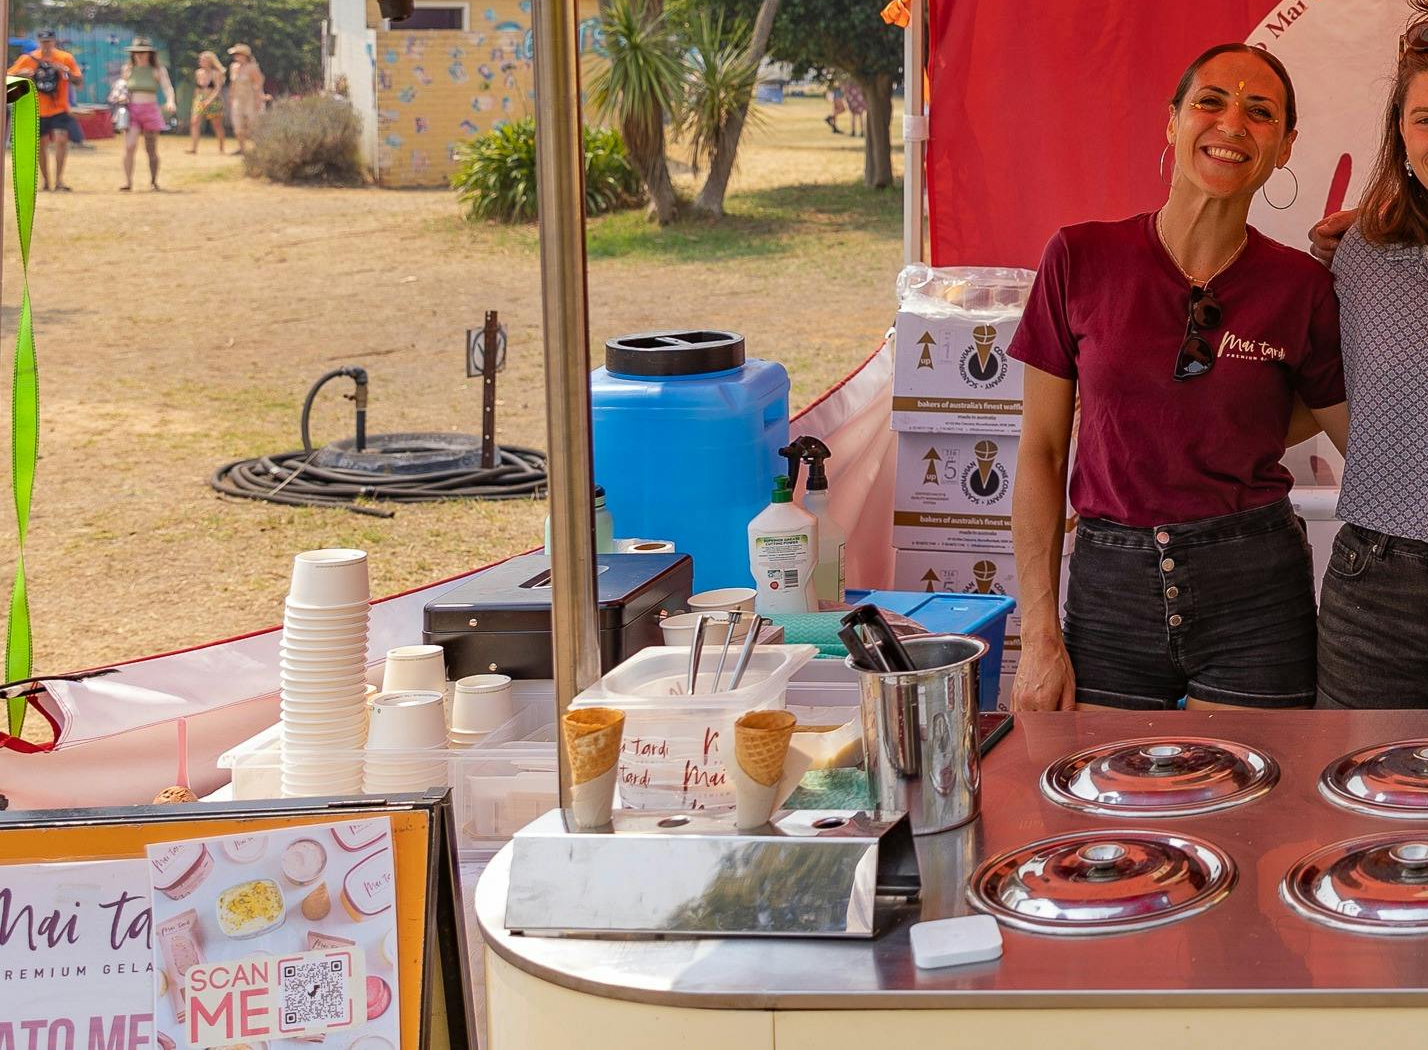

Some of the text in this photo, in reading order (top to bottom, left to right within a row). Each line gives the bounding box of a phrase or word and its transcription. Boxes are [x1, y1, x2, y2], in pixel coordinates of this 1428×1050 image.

[1217, 330, 1255, 358] Mai
[917, 400, 941, 409] bakers
[941, 400, 949, 409] of
[983, 402, 1003, 410] finest
[919, 515, 942, 524] bakers
[942, 516, 951, 524] of
[984, 517, 1003, 527] finest
[683, 760, 727, 792] Mai
[5, 962, 154, 981] REMIUM GELA
[190, 961, 269, 992] SCAN
[190, 987, 270, 1044] ME
